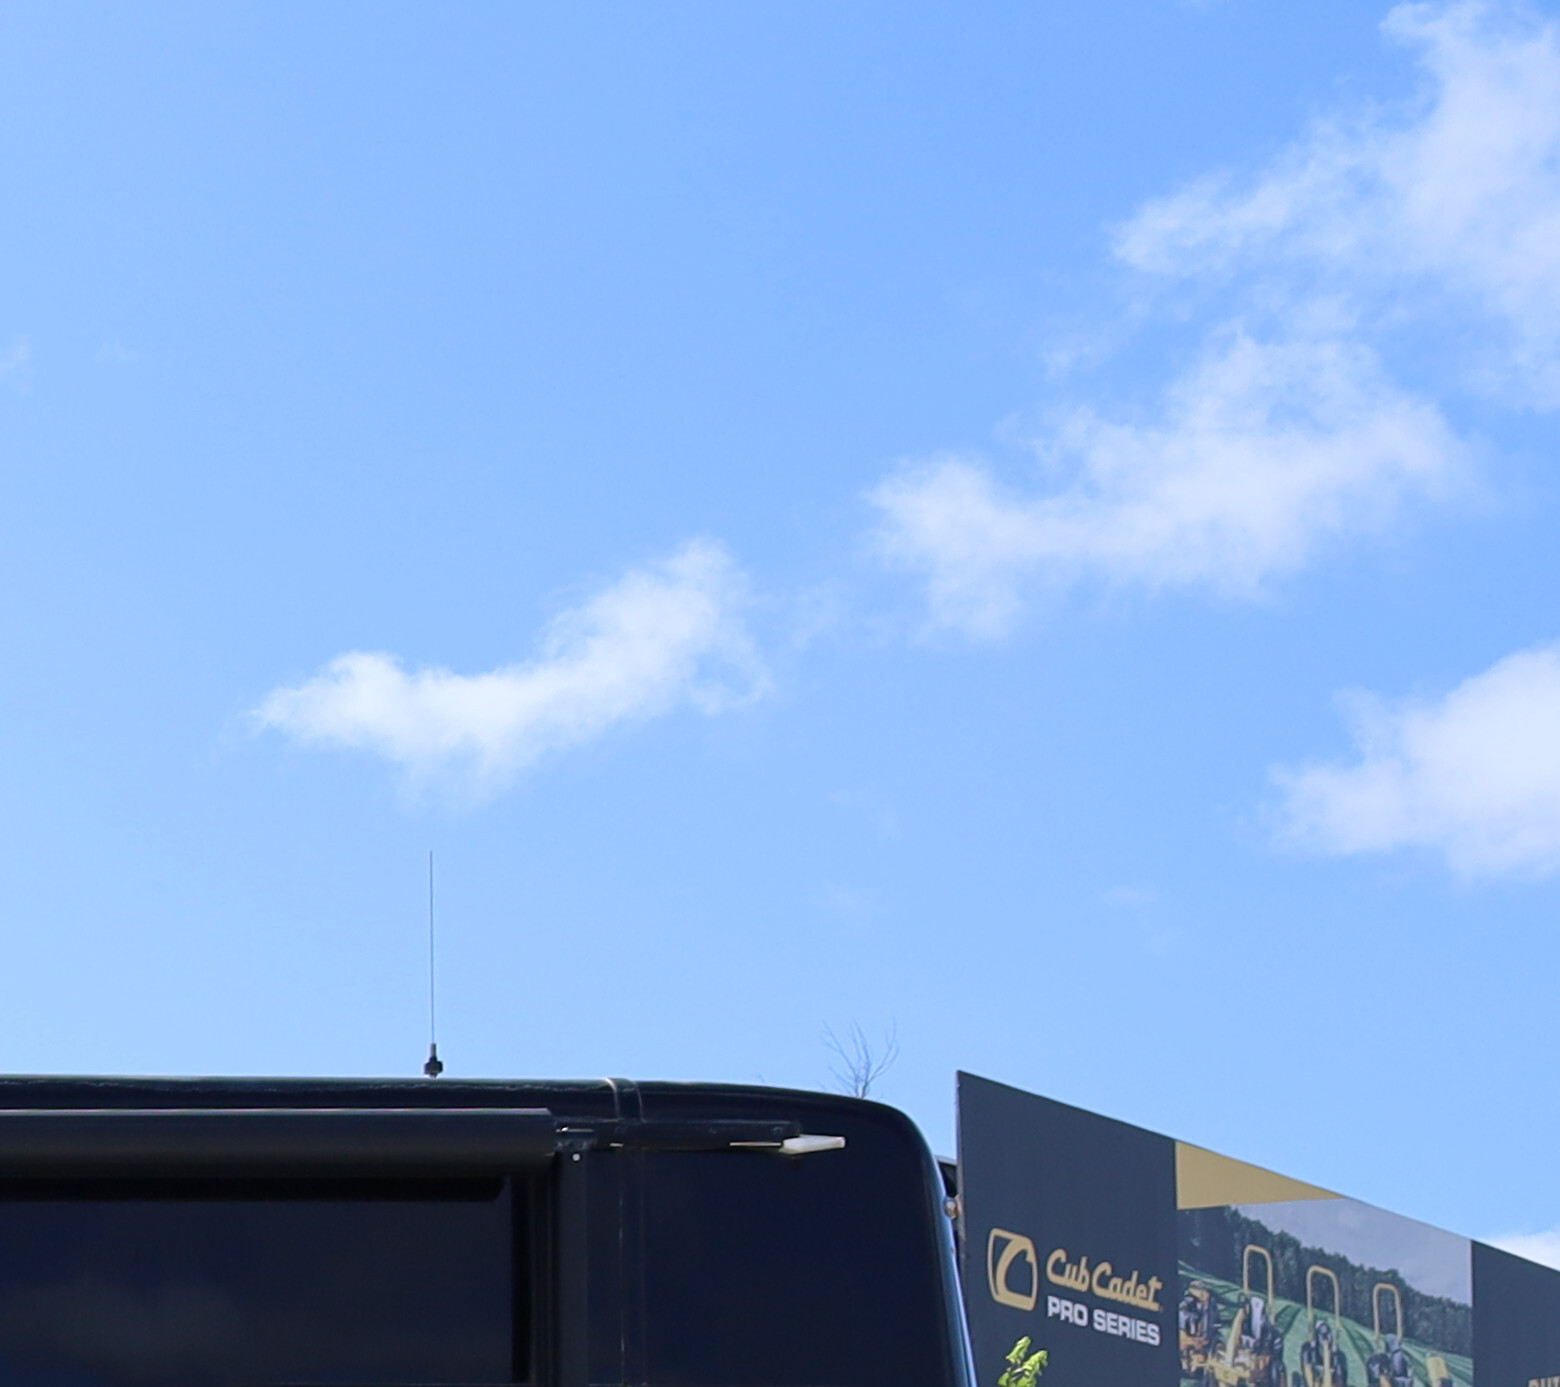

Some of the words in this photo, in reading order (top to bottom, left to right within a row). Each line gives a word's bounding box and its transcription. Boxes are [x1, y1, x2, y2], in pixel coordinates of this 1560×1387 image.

[1046, 1248, 1090, 1292] Cub
[1091, 1261, 1164, 1312] Cadet
[1047, 1295, 1089, 1327] PRO
[1093, 1308, 1161, 1346] SERIES
